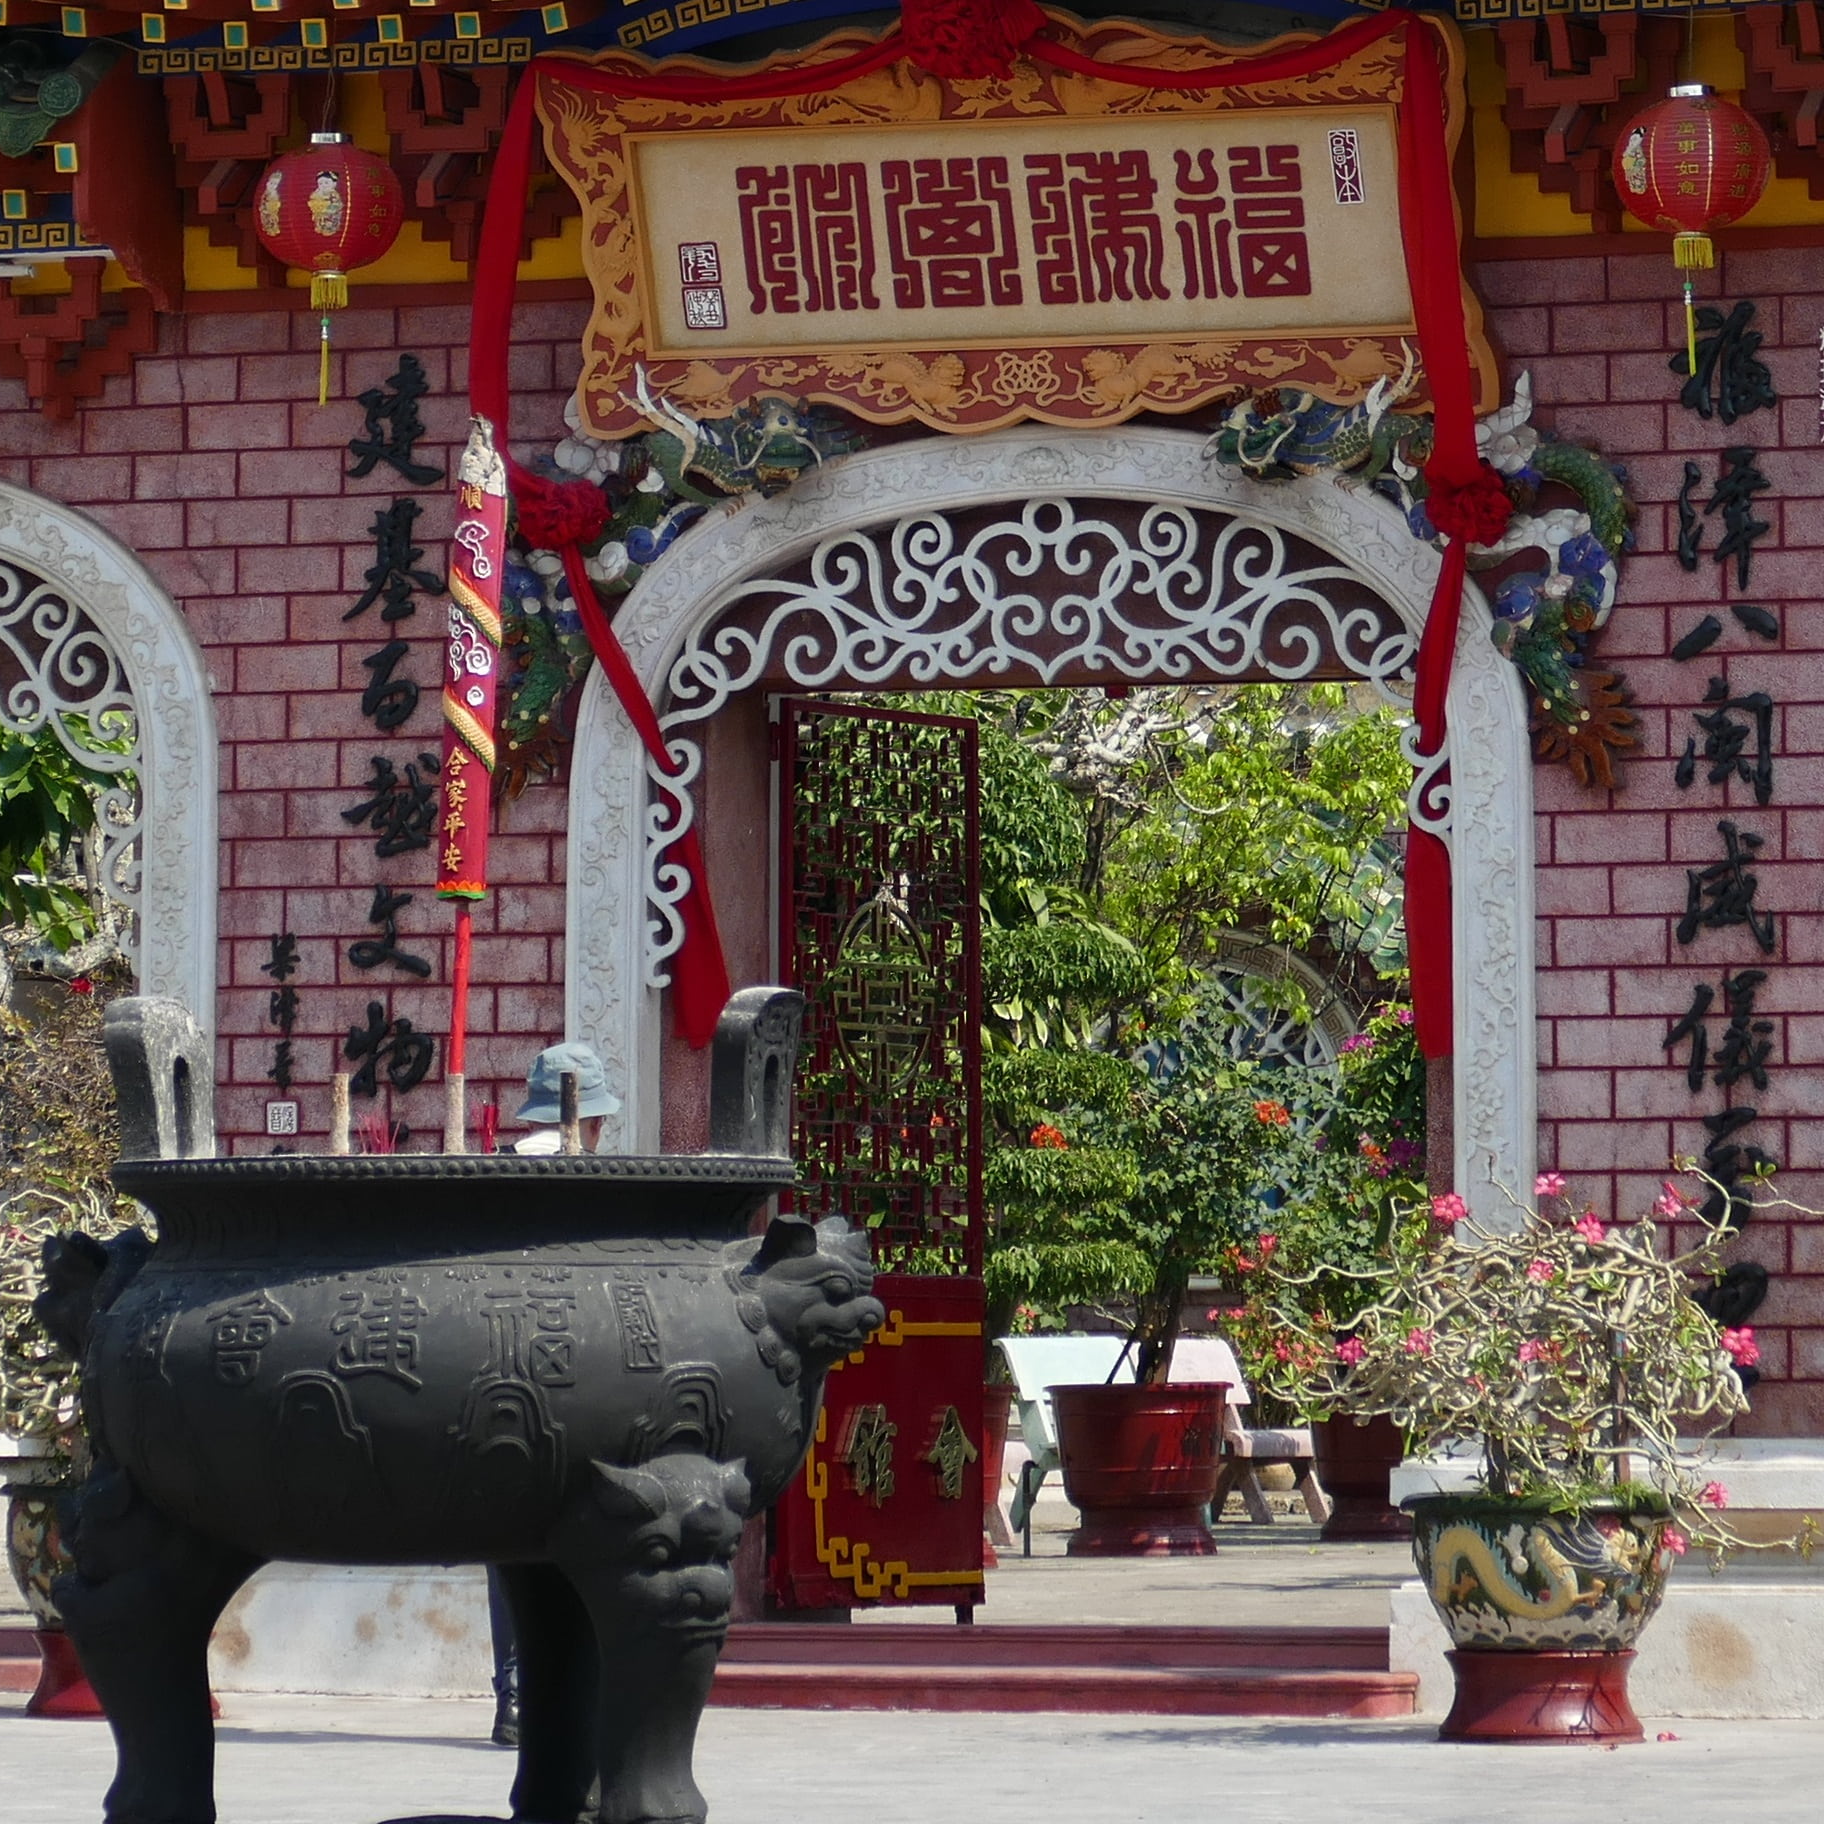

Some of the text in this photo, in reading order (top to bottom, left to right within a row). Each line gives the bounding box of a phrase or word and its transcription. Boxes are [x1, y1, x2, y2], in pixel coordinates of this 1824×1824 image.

[342, 352, 446, 1154] 建基百越文物
